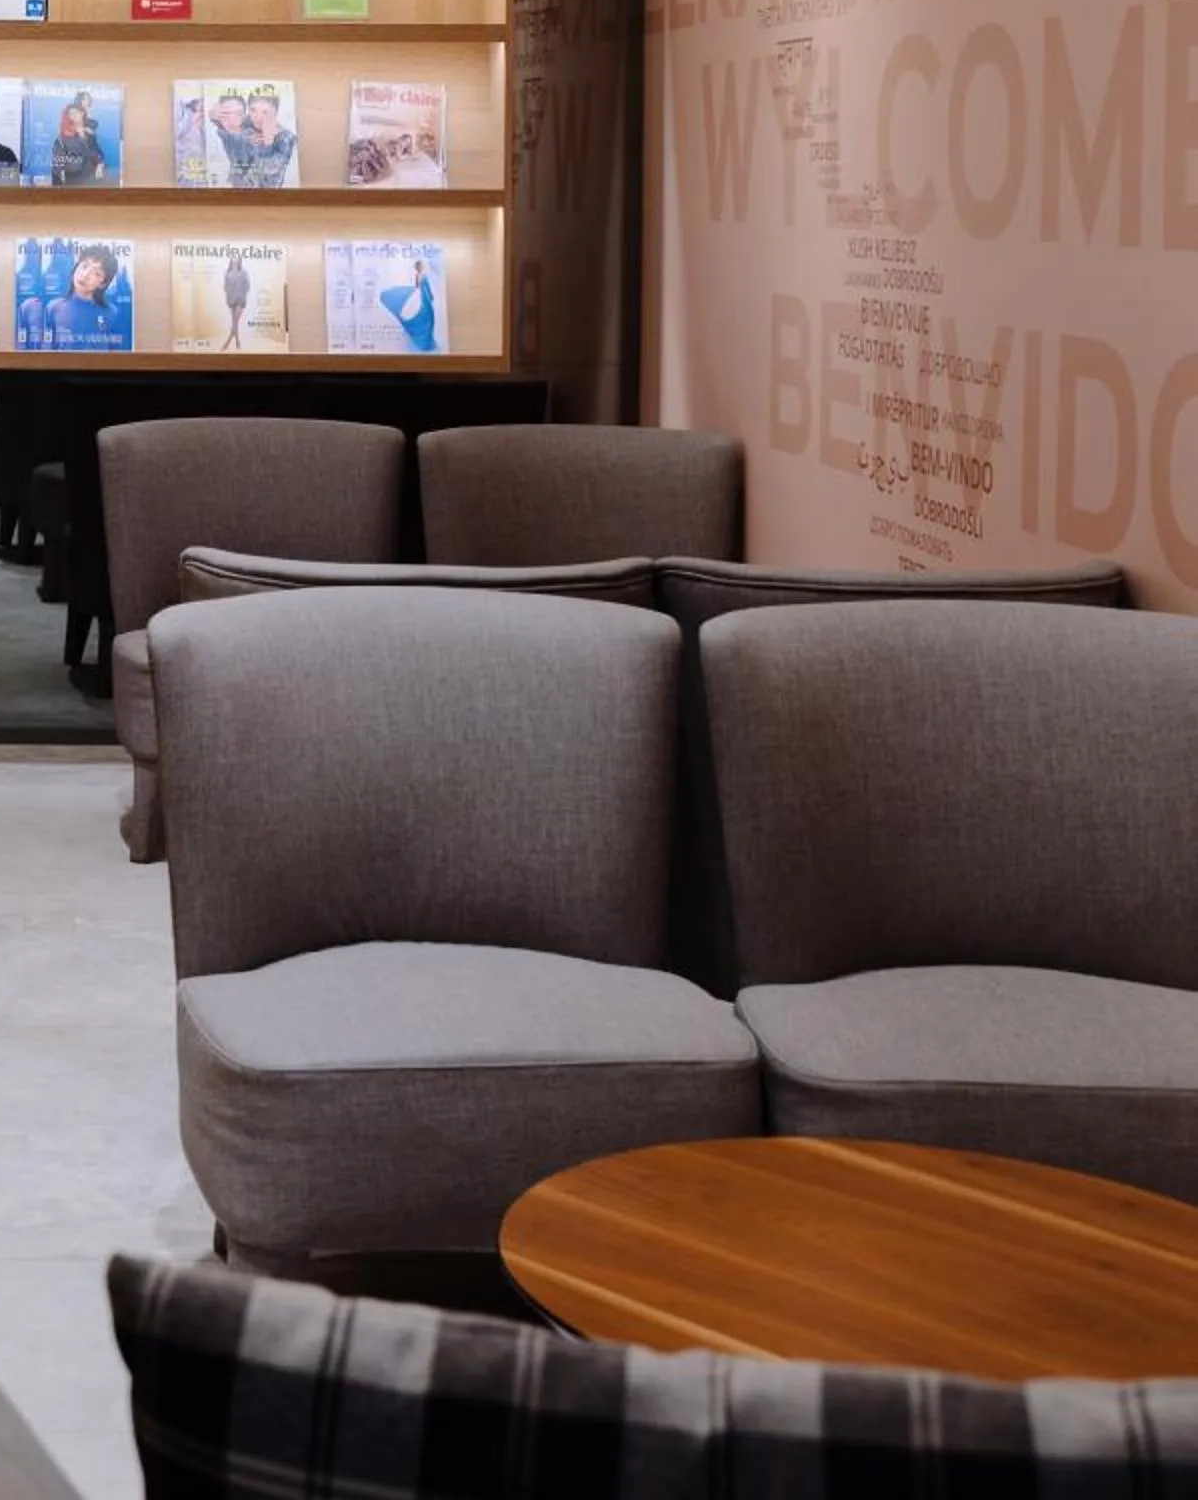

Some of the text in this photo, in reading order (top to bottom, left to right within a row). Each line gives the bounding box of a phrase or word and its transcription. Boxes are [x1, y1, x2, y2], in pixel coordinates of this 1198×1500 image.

[242, 244, 284, 261] claire
[860, 295, 930, 336] BIENVENUE
[911, 439, 994, 496] BEM-VINDO
